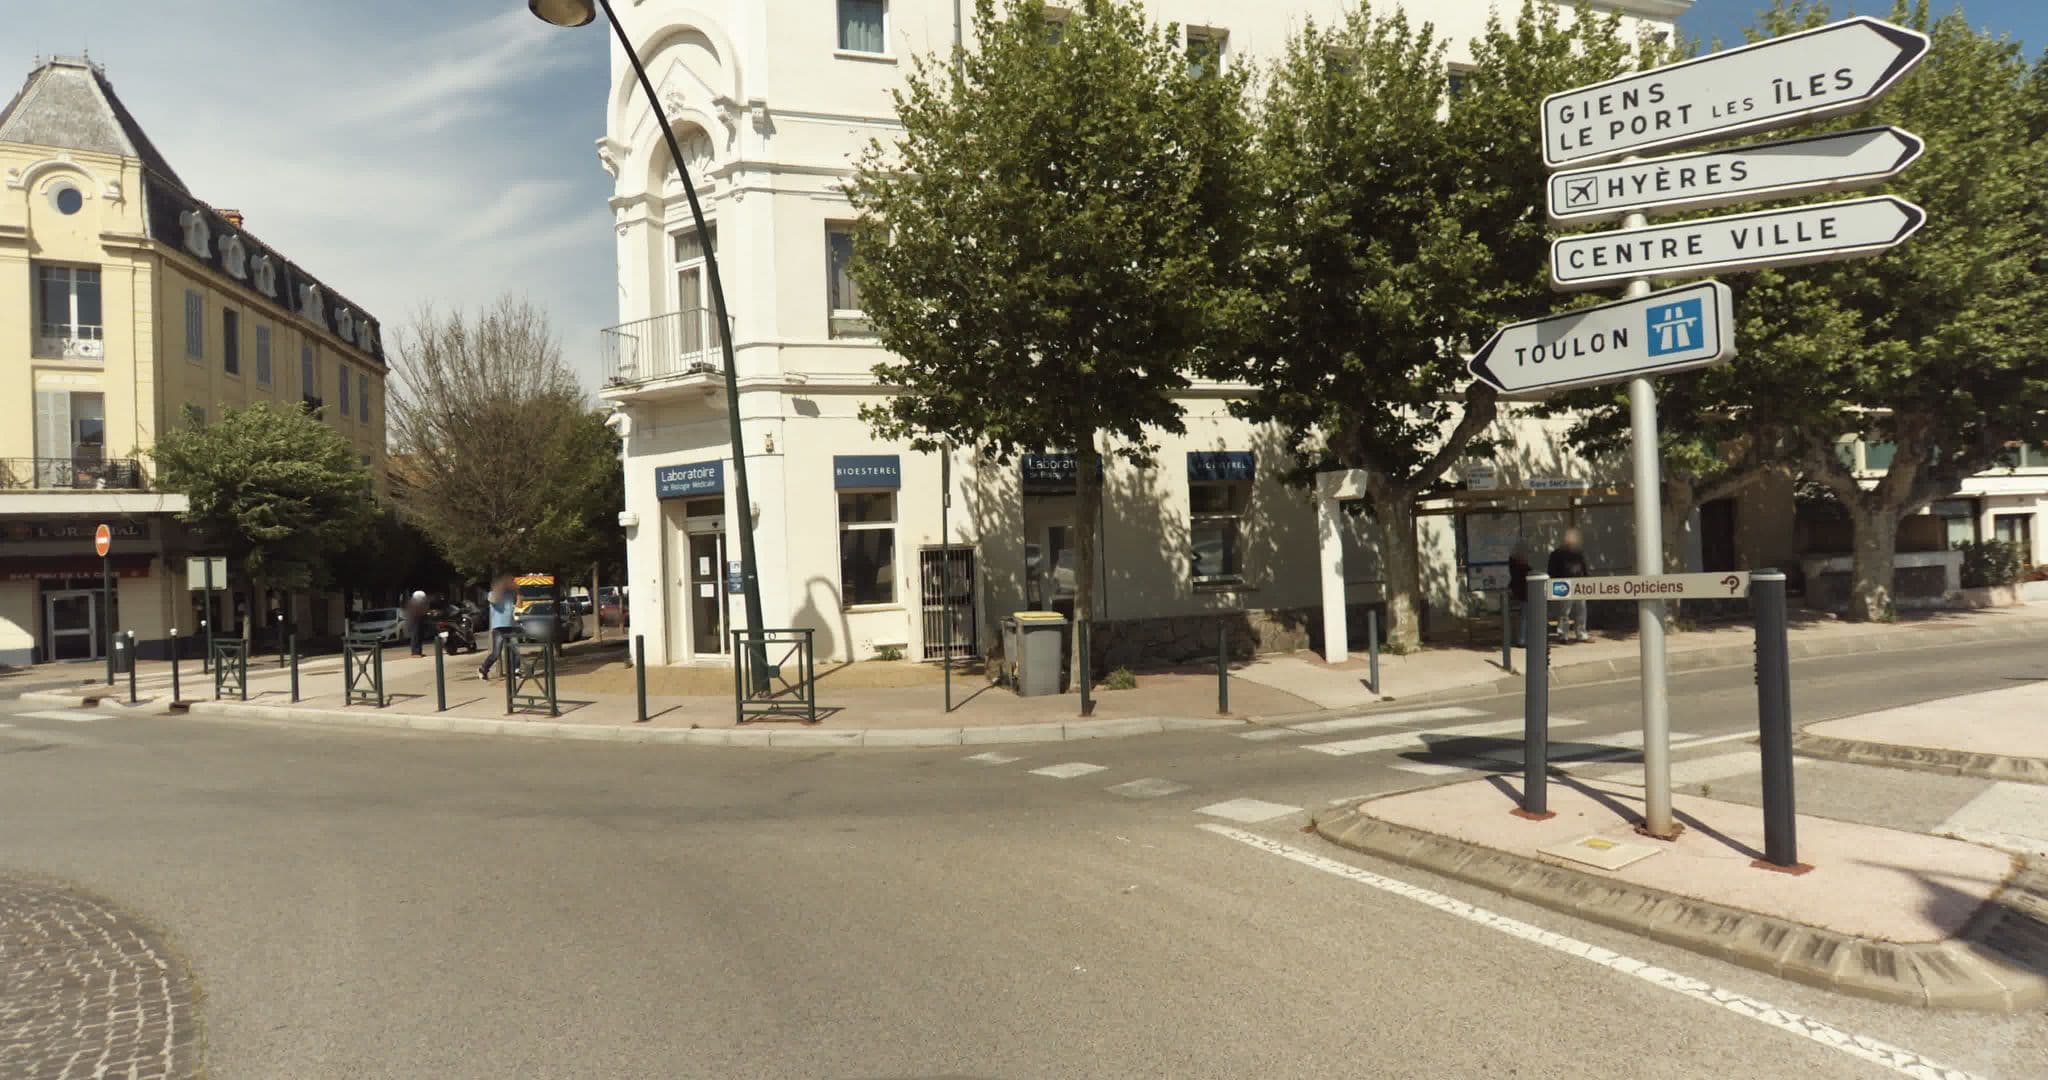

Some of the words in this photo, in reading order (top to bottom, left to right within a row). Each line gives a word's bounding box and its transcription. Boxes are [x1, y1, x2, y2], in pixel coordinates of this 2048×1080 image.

[1560, 83, 1665, 125] GIENS
[1561, 126, 1592, 151] LE
[1610, 104, 1693, 141] PORT
[1712, 97, 1755, 118] LES
[1772, 68, 1854, 104] ÎLES
[1608, 160, 1748, 198] HYÈRES
[1569, 234, 1703, 269] CENTRE
[1731, 217, 1837, 250] VILLE
[1514, 328, 1629, 367] TOULON
[661, 467, 715, 482] Laboratoire
[836, 467, 897, 476] BIOESTEREL
[1574, 582, 1596, 595] Atol
[1600, 581, 1620, 594] Les
[1624, 581, 1684, 597] Opticiens
